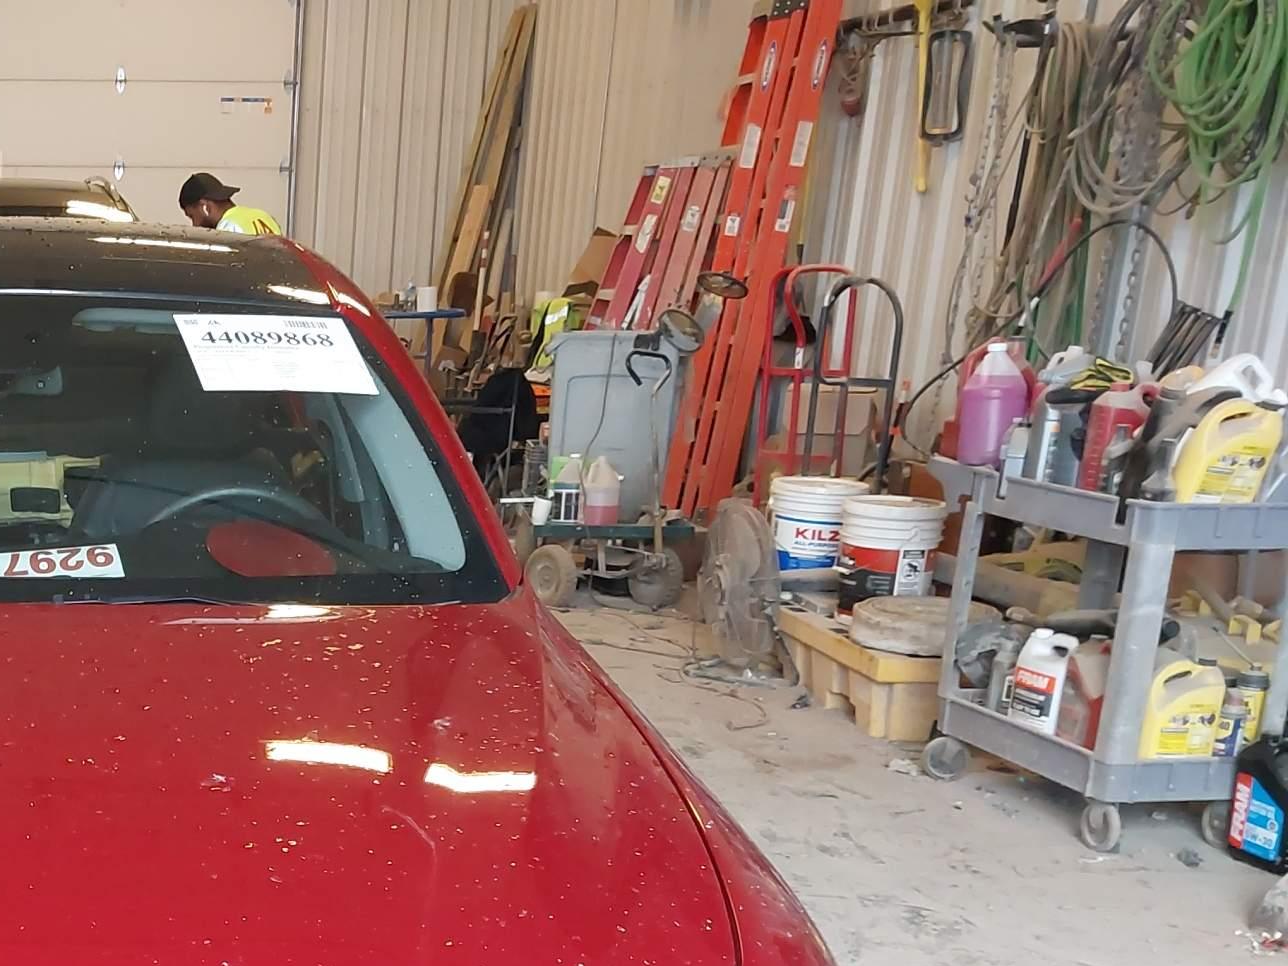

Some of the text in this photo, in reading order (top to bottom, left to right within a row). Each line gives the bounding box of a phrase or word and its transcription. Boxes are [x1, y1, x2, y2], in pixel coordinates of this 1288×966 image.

[201, 331, 335, 347] 44089868
[3, 546, 115, 576] 9297
[1229, 782, 1251, 841] FRAM
